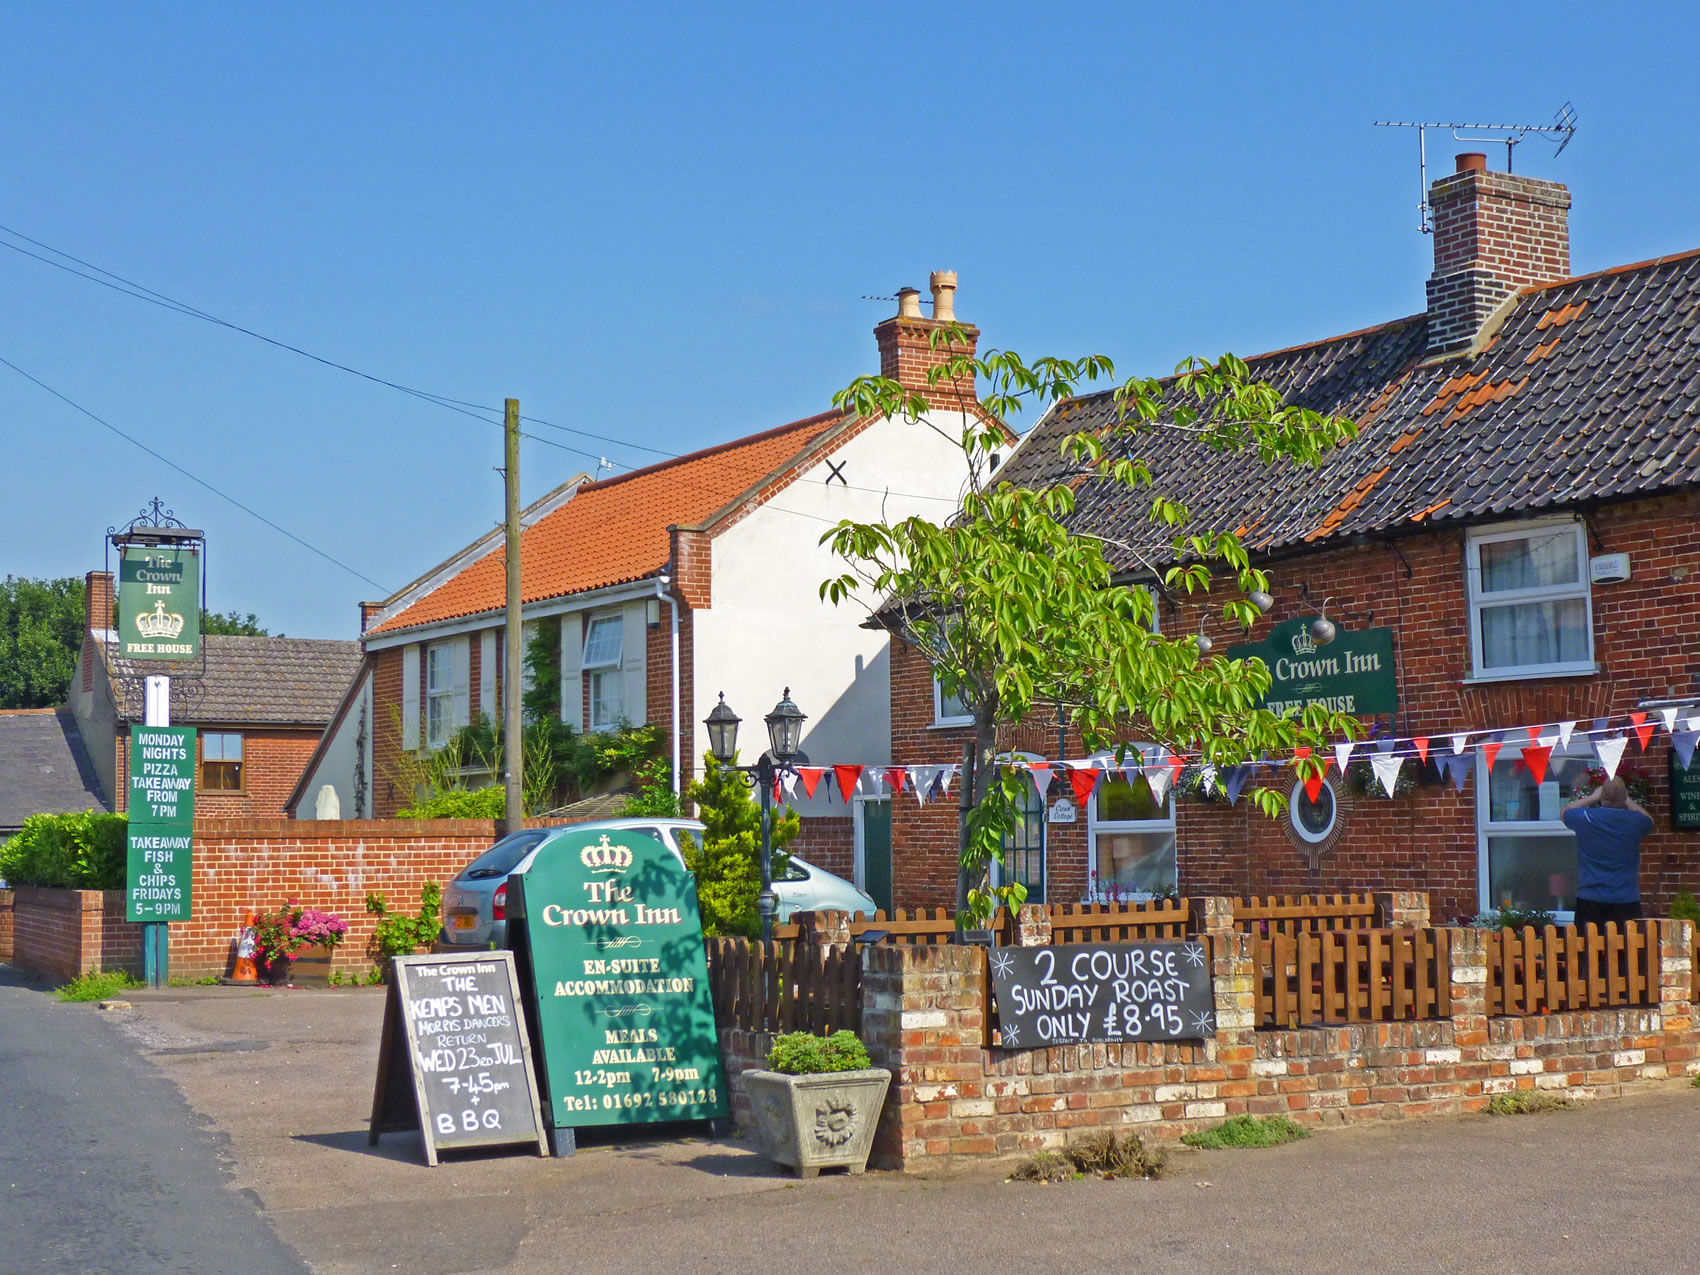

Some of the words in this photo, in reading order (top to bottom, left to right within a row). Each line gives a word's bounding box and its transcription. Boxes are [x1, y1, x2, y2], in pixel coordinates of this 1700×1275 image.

[146, 555, 172, 569] The
[136, 570, 182, 582] Crown
[146, 583, 171, 594] Inn
[127, 643, 154, 653] FREE
[157, 643, 192, 653] HOUSE
[1276, 657, 1340, 680] Crown
[1344, 650, 1382, 674] Inn
[138, 733, 185, 747] MONDAY
[143, 748, 187, 760] NIGHTS
[143, 763, 178, 776] PIZZA
[131, 776, 191, 790] TAKEAWAY
[146, 790, 178, 803] FROM
[1689, 803, 1696, 811] &
[130, 837, 191, 849] TAKEAWAY
[144, 851, 173, 863] FISH
[153, 863, 163, 874] &
[139, 875, 176, 887] CHIPS
[132, 888, 182, 900] FRIDAYS
[583, 879, 634, 903] The
[542, 904, 630, 926] Crown
[634, 903, 682, 925] Inn
[416, 966, 438, 977] The
[439, 965, 475, 976] Crown
[477, 963, 496, 974] Inn
[583, 959, 660, 975] EN-SUITE
[1034, 950, 1058, 985] 2
[1071, 949, 1179, 981] COURSE
[441, 976, 479, 992] THE
[554, 978, 694, 997] ACCOMMODATION
[1011, 984, 1098, 1015] SUNDAY
[1112, 978, 1190, 1003] ROAST
[409, 997, 463, 1020] KEMPS
[467, 994, 506, 1015] MEN
[418, 1019, 461, 1036] MORRIS
[463, 1015, 511, 1031] DANCERS
[1036, 1012, 1091, 1040] ONLY
[437, 1033, 487, 1047] RETURN
[605, 1029, 658, 1045] MEALS
[418, 1050, 457, 1072] WED
[487, 1043, 523, 1065] JUL
[592, 1047, 676, 1065] AVAILABLE
[574, 1070, 632, 1088] 12-2pm
[652, 1067, 699, 1084] 7-9pm
[564, 1096, 598, 1112] Tel:
[603, 1093, 653, 1110] 01692
[659, 1089, 717, 1106] 580128
